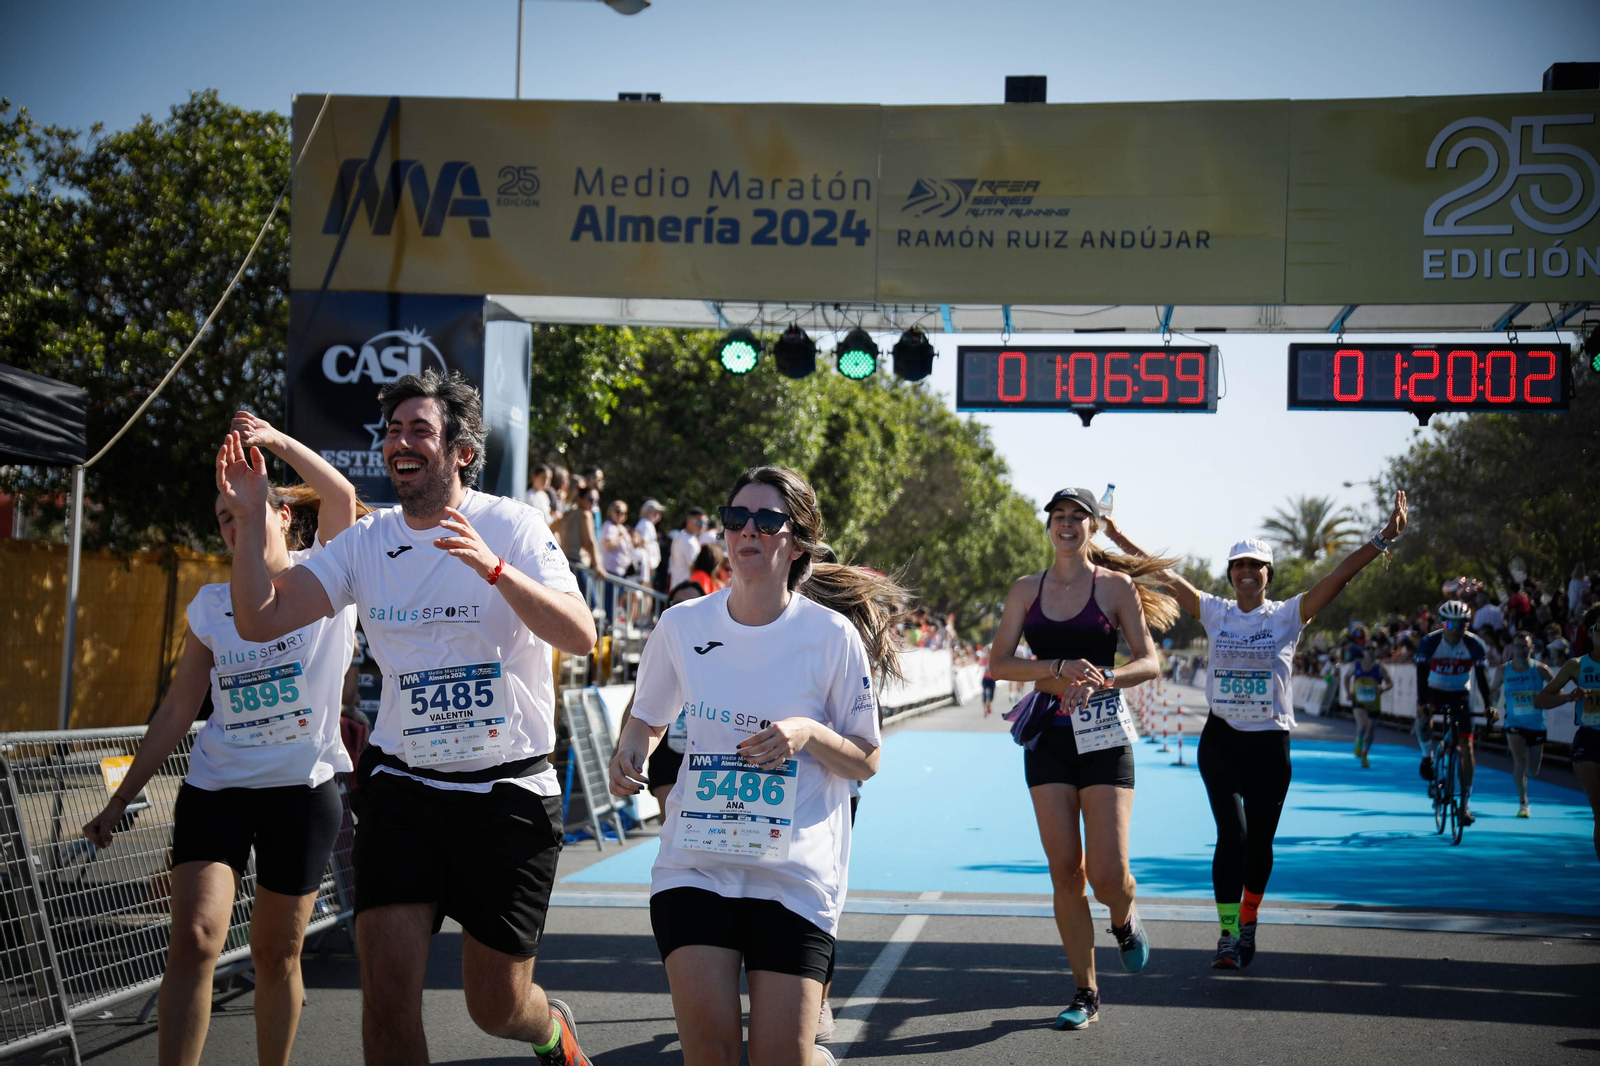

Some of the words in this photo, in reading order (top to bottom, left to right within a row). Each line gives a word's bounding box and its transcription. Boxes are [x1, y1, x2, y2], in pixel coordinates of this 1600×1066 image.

[497, 165, 540, 196] 25
[573, 167, 690, 198] Medio
[708, 170, 871, 201] Maratón
[1423, 113, 1600, 237] 25
[978, 180, 1040, 195] RFEA
[496, 197, 540, 207] EDICIÓN
[971, 196, 1034, 207] SERIES
[965, 208, 1004, 218] RUTA
[1009, 208, 1070, 218] RUNNING
[570, 204, 741, 245] Almería
[750, 208, 872, 247] 2024
[897, 226, 994, 249] RAMÓN
[1006, 230, 1069, 249] RUIZ
[1079, 227, 1211, 250] ANDÚJAR
[1423, 239, 1600, 280] EDICIÓN
[322, 344, 422, 384] CASI
[320, 450, 384, 468] ESTR
[367, 467, 388, 476] LEV
[369, 605, 419, 622] salus
[229, 677, 299, 714] 5895
[1220, 678, 1267, 695] 5698
[411, 680, 494, 716] 5485
[429, 709, 474, 722] VALENTIN
[684, 701, 731, 723] salus
[1095, 715, 1118, 725] CARMEN
[696, 770, 785, 806] 5486
[725, 801, 745, 810] ANA
